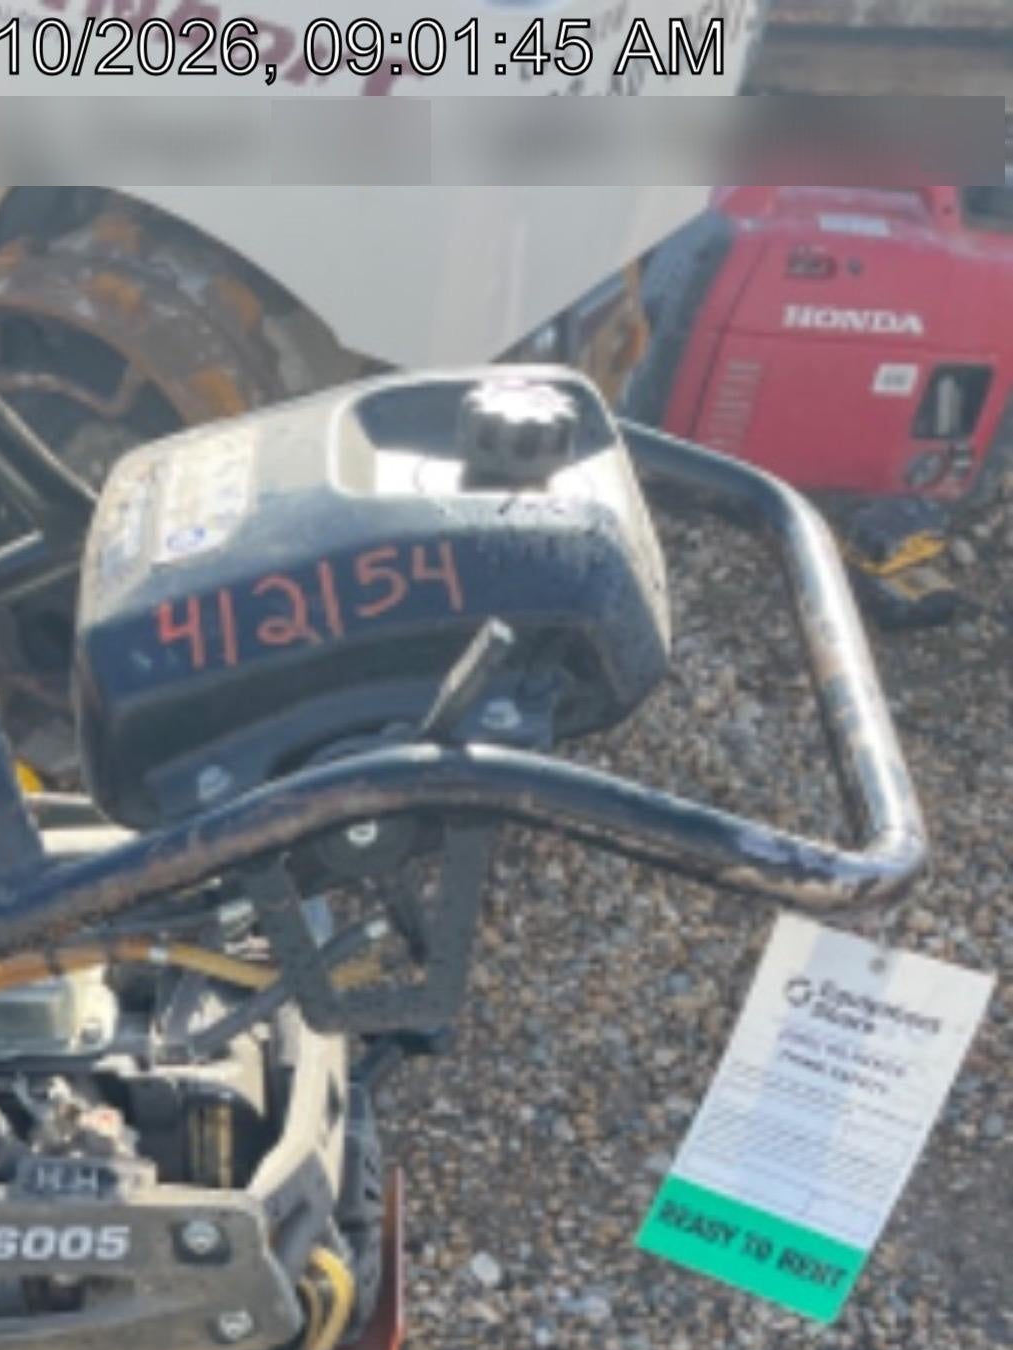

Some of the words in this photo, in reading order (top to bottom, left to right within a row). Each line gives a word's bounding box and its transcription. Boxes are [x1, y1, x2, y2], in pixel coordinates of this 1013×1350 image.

[783, 304, 926, 337] HONDA
[156, 540, 465, 669] 412154
[657, 1199, 740, 1248] READY
[742, 1230, 775, 1264] TO
[777, 1247, 849, 1290] RENT
